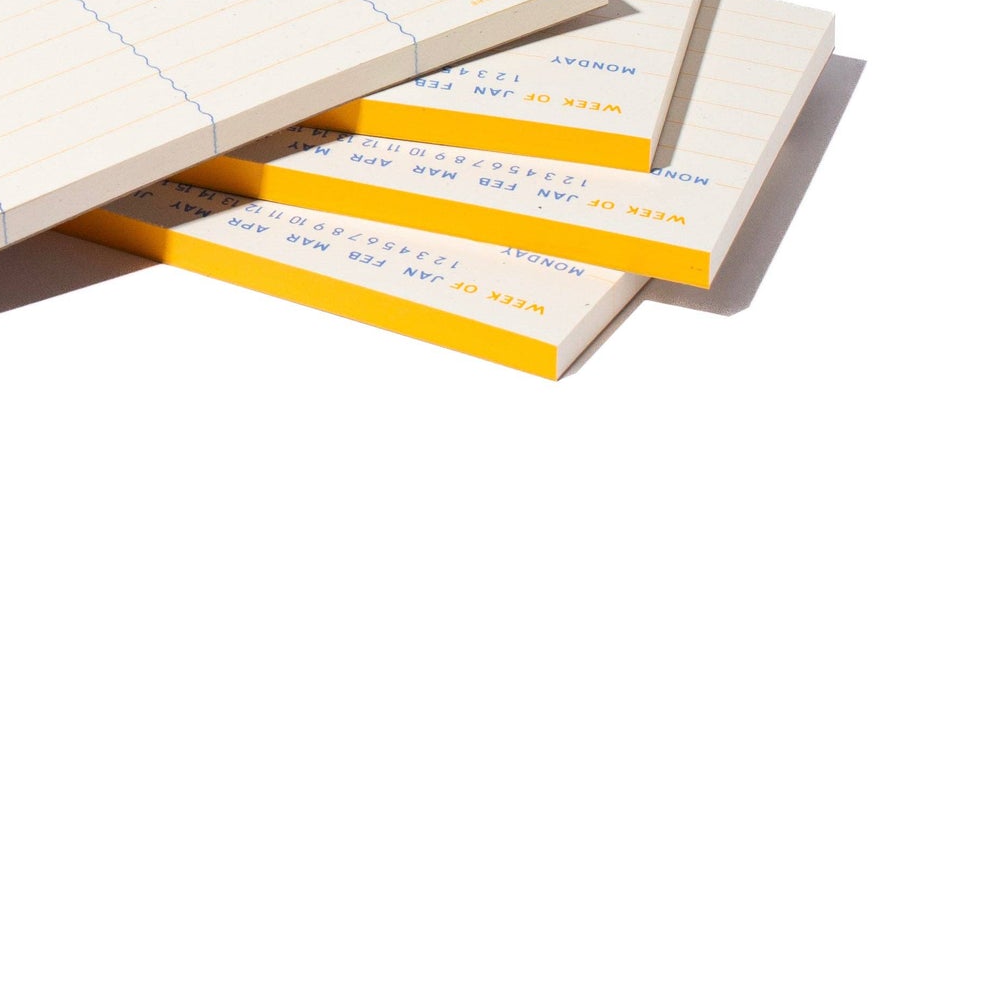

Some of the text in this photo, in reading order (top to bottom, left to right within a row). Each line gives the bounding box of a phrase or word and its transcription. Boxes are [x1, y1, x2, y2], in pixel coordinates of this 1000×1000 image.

[551, 56, 636, 75] MONDAY
[459, 67, 469, 76] 4
[477, 70, 488, 79] 3
[496, 72, 506, 81] 2
[514, 74, 519, 83] 1
[415, 78, 622, 114] WEEK OF JAN FEB
[336, 134, 355, 143] 13
[362, 138, 379, 148] 12
[387, 143, 400, 152] 11
[409, 148, 426, 157] 10
[435, 152, 445, 160] 9
[454, 156, 466, 164] 8
[472, 160, 484, 168] 7
[492, 162, 503, 170] 6
[508, 166, 520, 174] 5
[526, 169, 537, 177] 4
[544, 172, 556, 181] 3
[651, 168, 710, 186] MOND
[288, 141, 686, 226] WEEK OF JAN FEB MAR APR MAY
[563, 176, 575, 185] 2
[581, 179, 587, 187] 1
[222, 197, 240, 207] 13
[245, 203, 263, 214] 12
[268, 210, 283, 219] 11
[289, 216, 307, 226] 10
[313, 223, 325, 231] 9
[331, 227, 344, 236] 8
[347, 233, 363, 241] 7
[367, 237, 379, 245] 6
[382, 242, 396, 251] 5
[399, 246, 411, 254] 4
[170, 201, 545, 316] WEEK OF JAN FEB MAR APR MAY
[416, 251, 430, 260] 3
[434, 256, 447, 265] 2
[450, 261, 459, 269] 1
[500, 246, 585, 277] MONDAY
